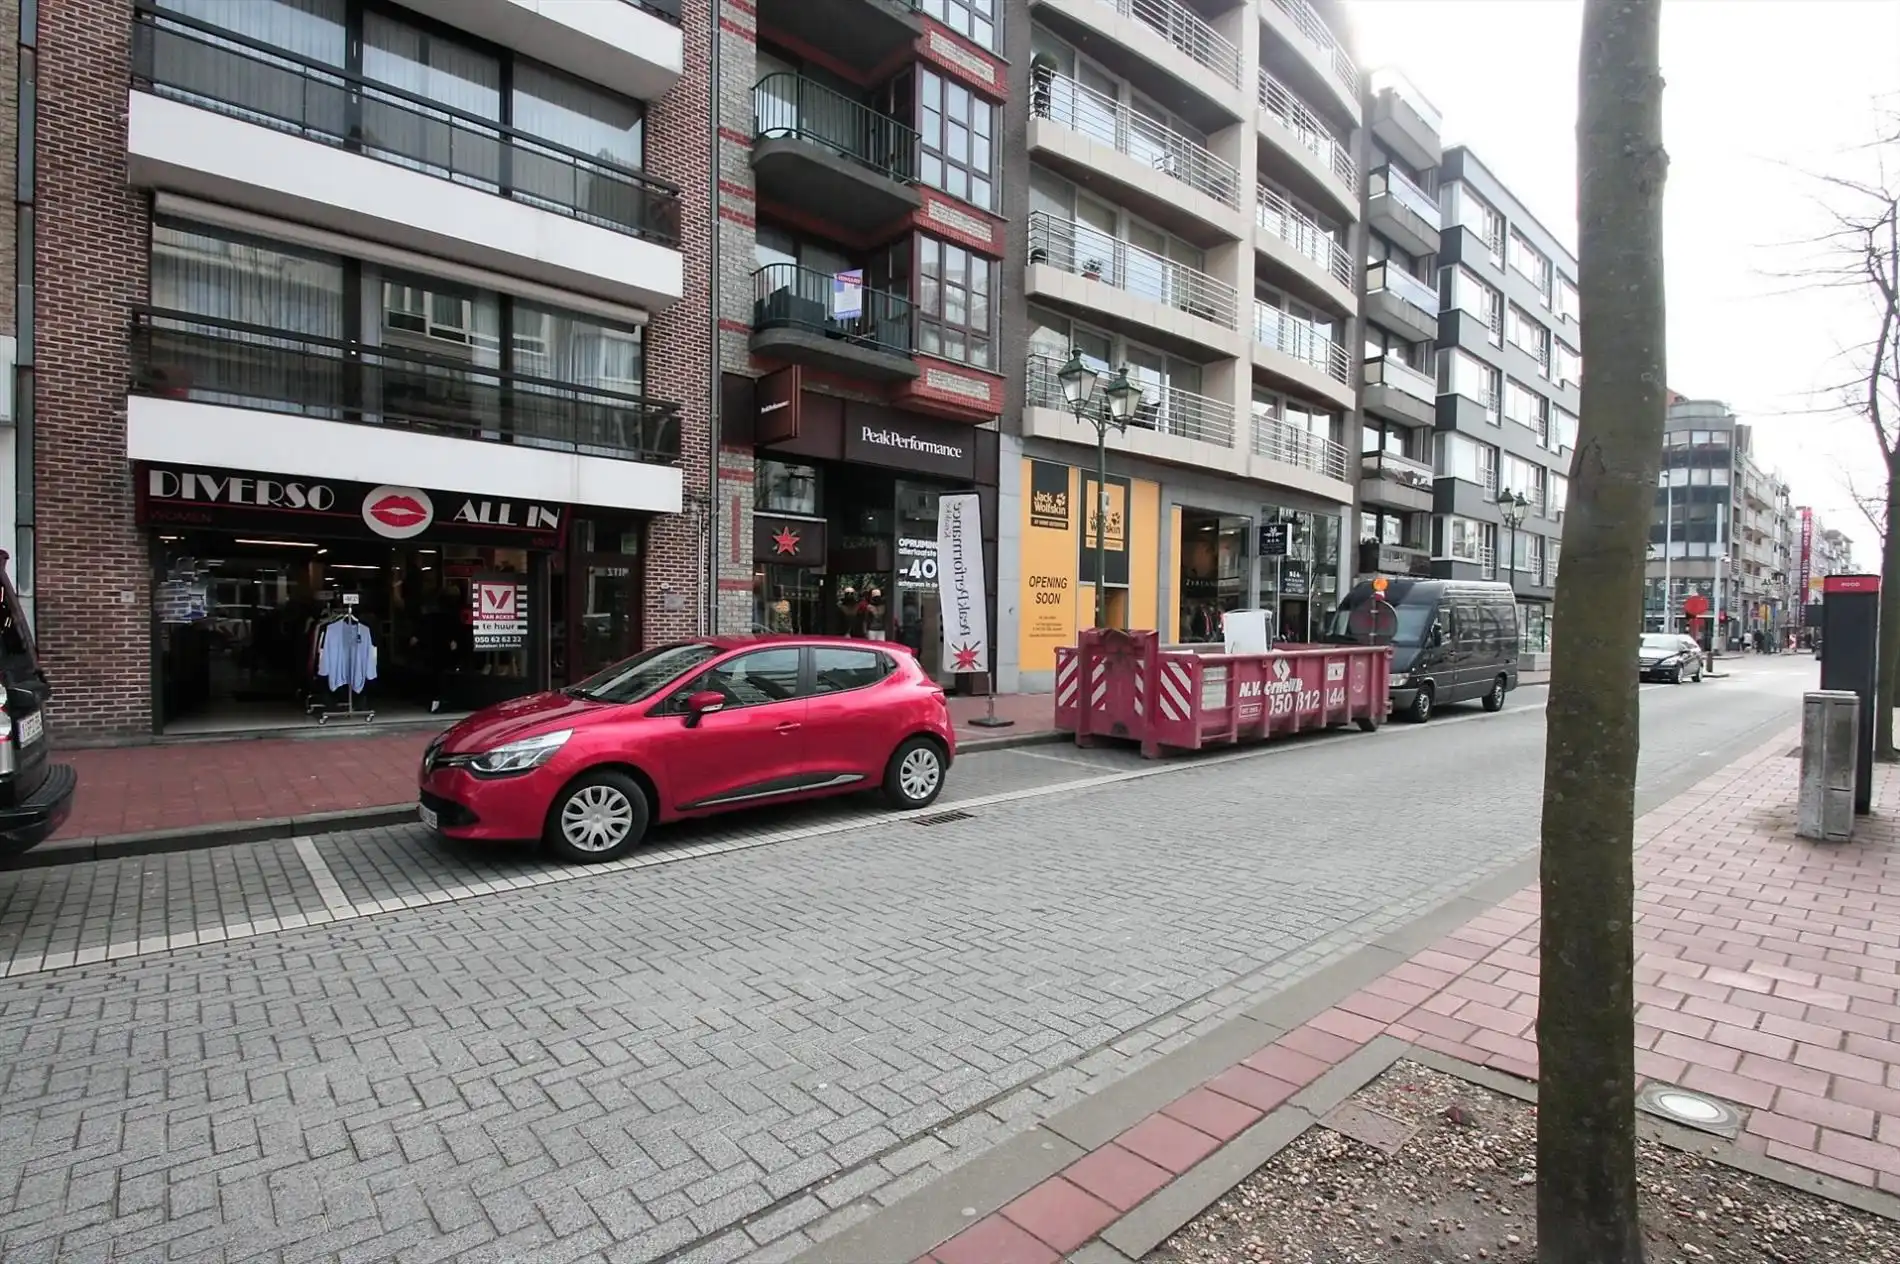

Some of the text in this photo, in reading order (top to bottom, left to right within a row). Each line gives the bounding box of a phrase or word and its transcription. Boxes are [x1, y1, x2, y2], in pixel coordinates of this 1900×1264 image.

[862, 425, 962, 458] PeakPerformance
[149, 469, 335, 511] DIVERSO
[1034, 490, 1053, 503] Jack
[453, 499, 560, 529] ALL IN
[1033, 500, 1066, 515] Wolfskin
[1028, 575, 1068, 589] OPENING
[1035, 592, 1061, 605] SOON
[494, 622, 515, 630] huur
[474, 635, 490, 643] 050
[1239, 682, 1262, 697] N.V.
